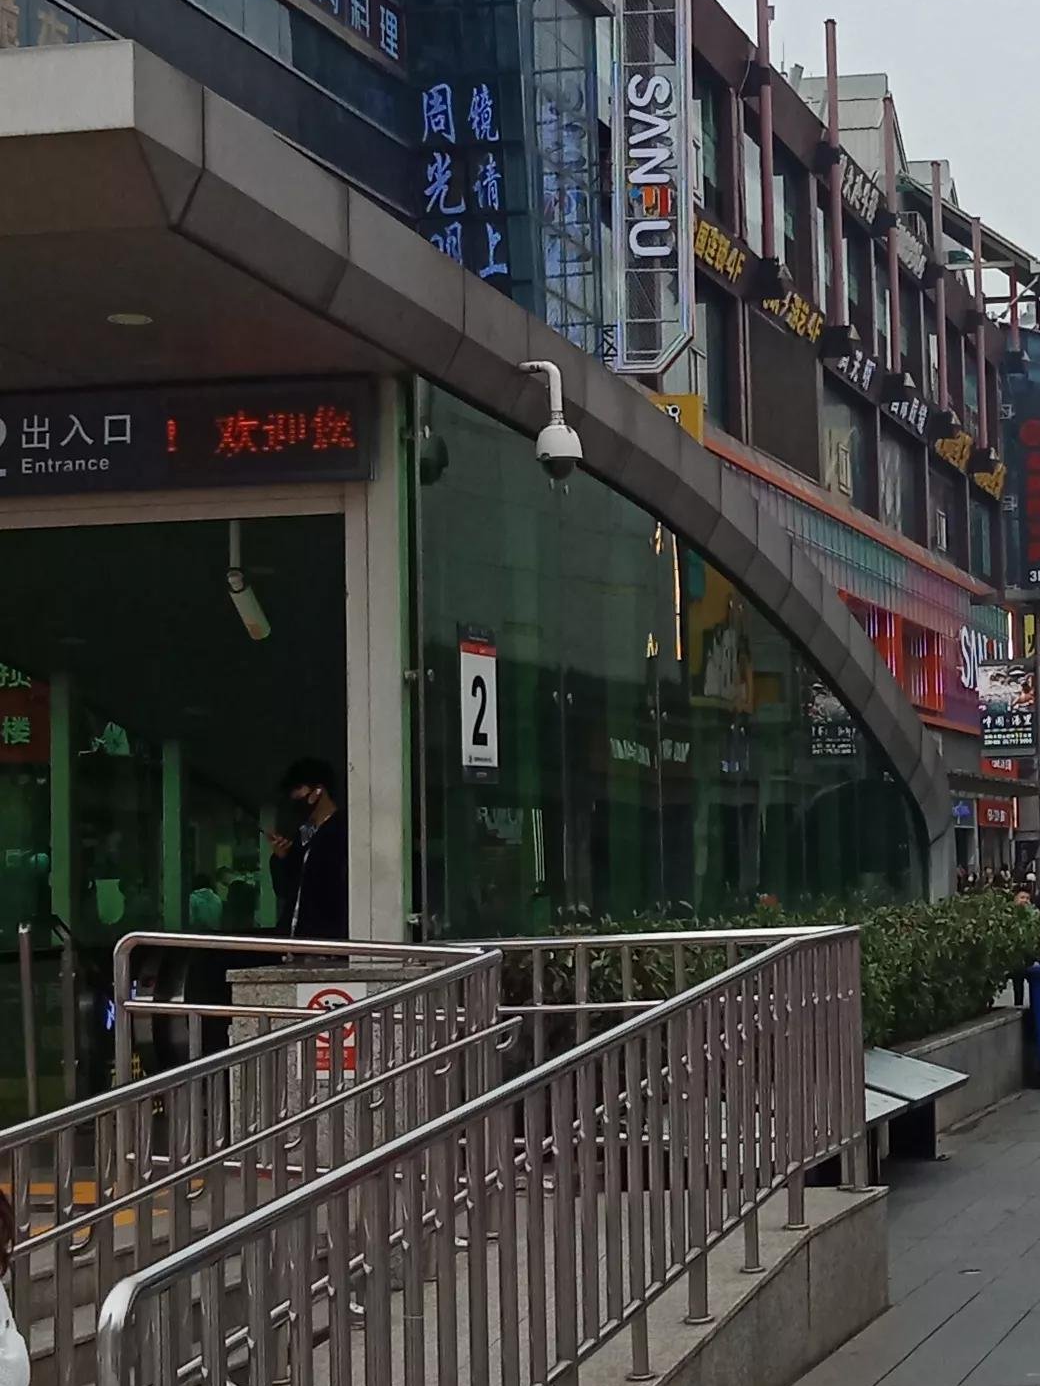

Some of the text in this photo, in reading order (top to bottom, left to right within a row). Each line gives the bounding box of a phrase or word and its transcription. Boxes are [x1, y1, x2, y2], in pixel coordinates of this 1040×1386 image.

[21, 414, 131, 451] 出入口
[21, 458, 110, 475] Entrance
[471, 675, 489, 747] 2
